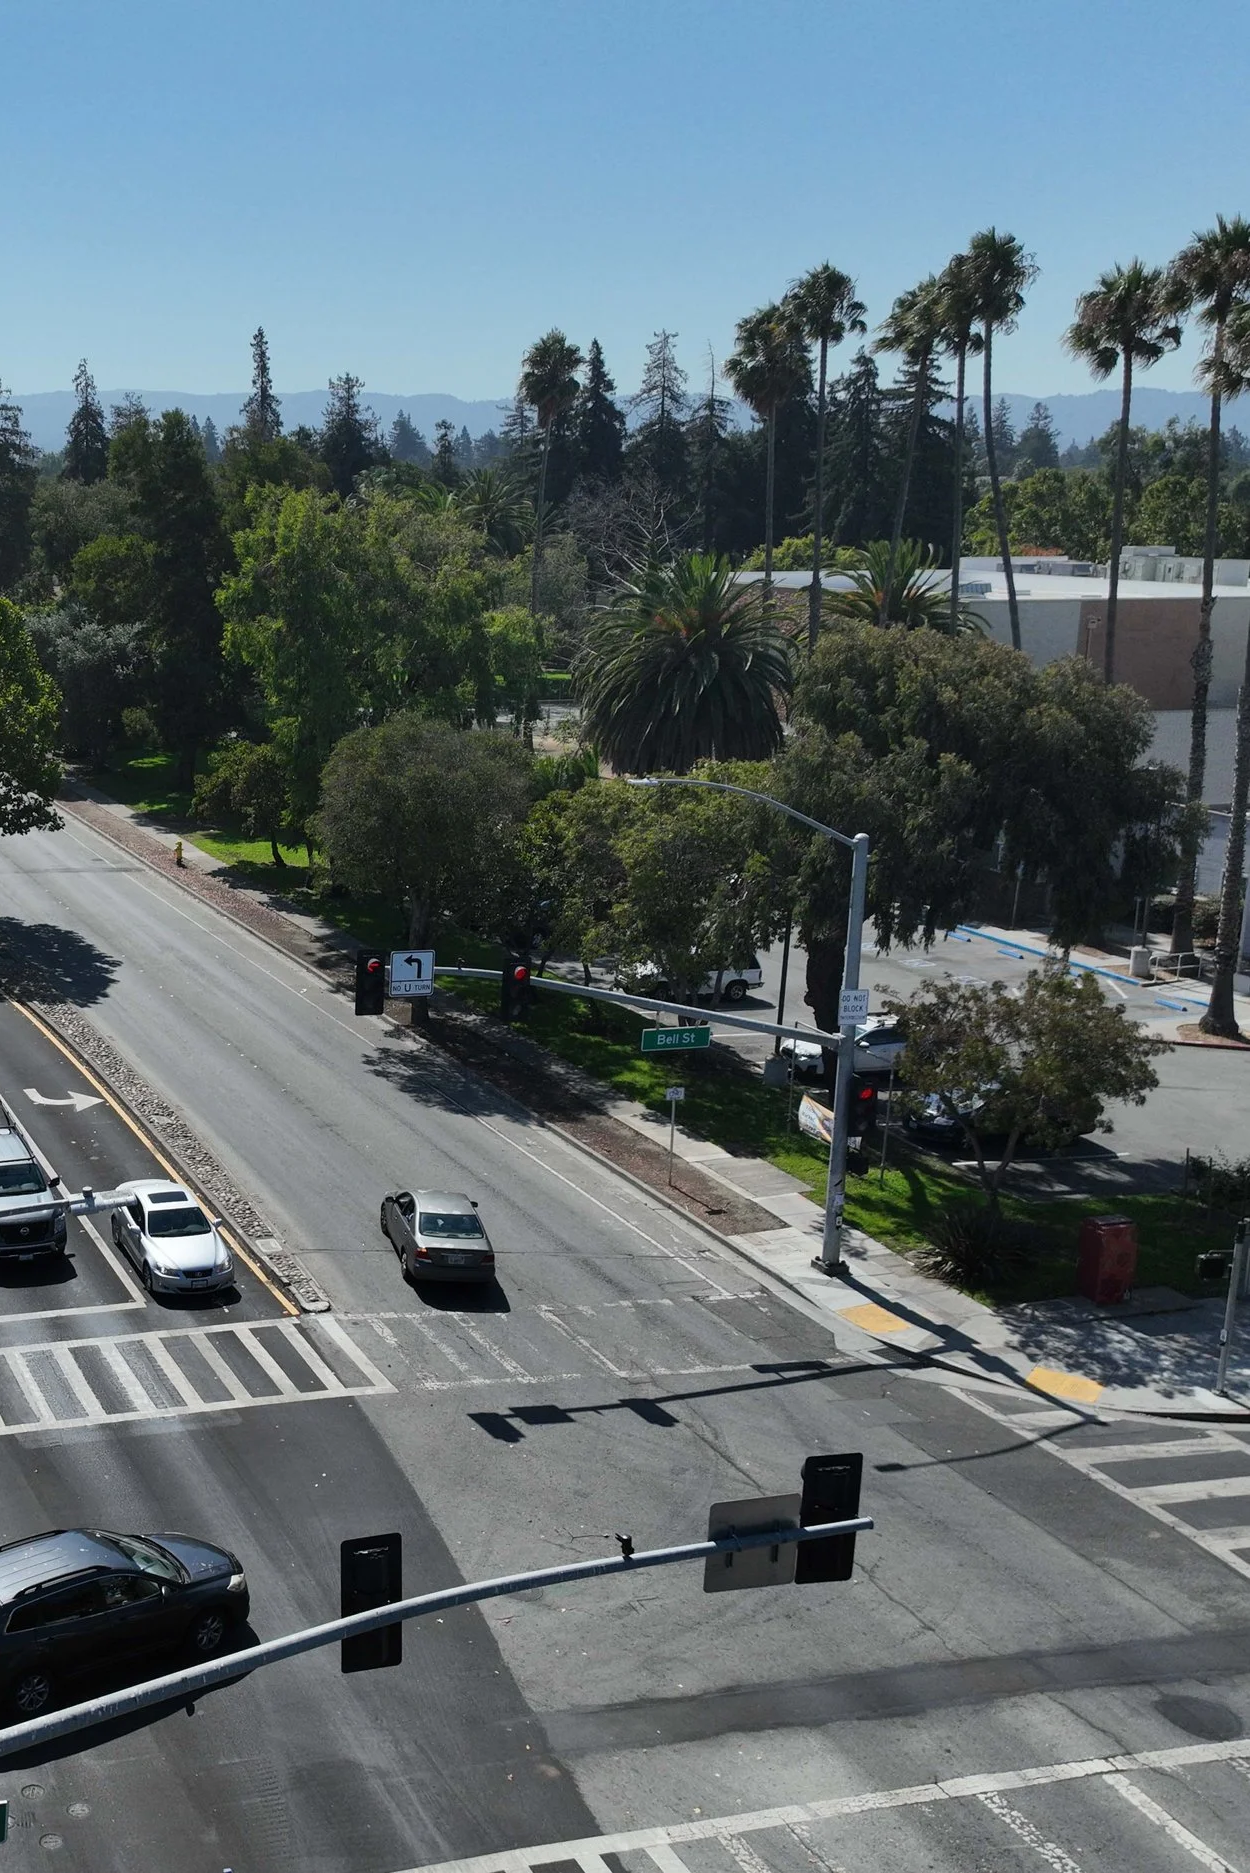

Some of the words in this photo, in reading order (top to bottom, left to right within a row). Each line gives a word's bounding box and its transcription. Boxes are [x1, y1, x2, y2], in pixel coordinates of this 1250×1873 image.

[405, 984, 411, 992] U
[657, 1034, 679, 1045] Bell
[682, 1033, 696, 1043] St
